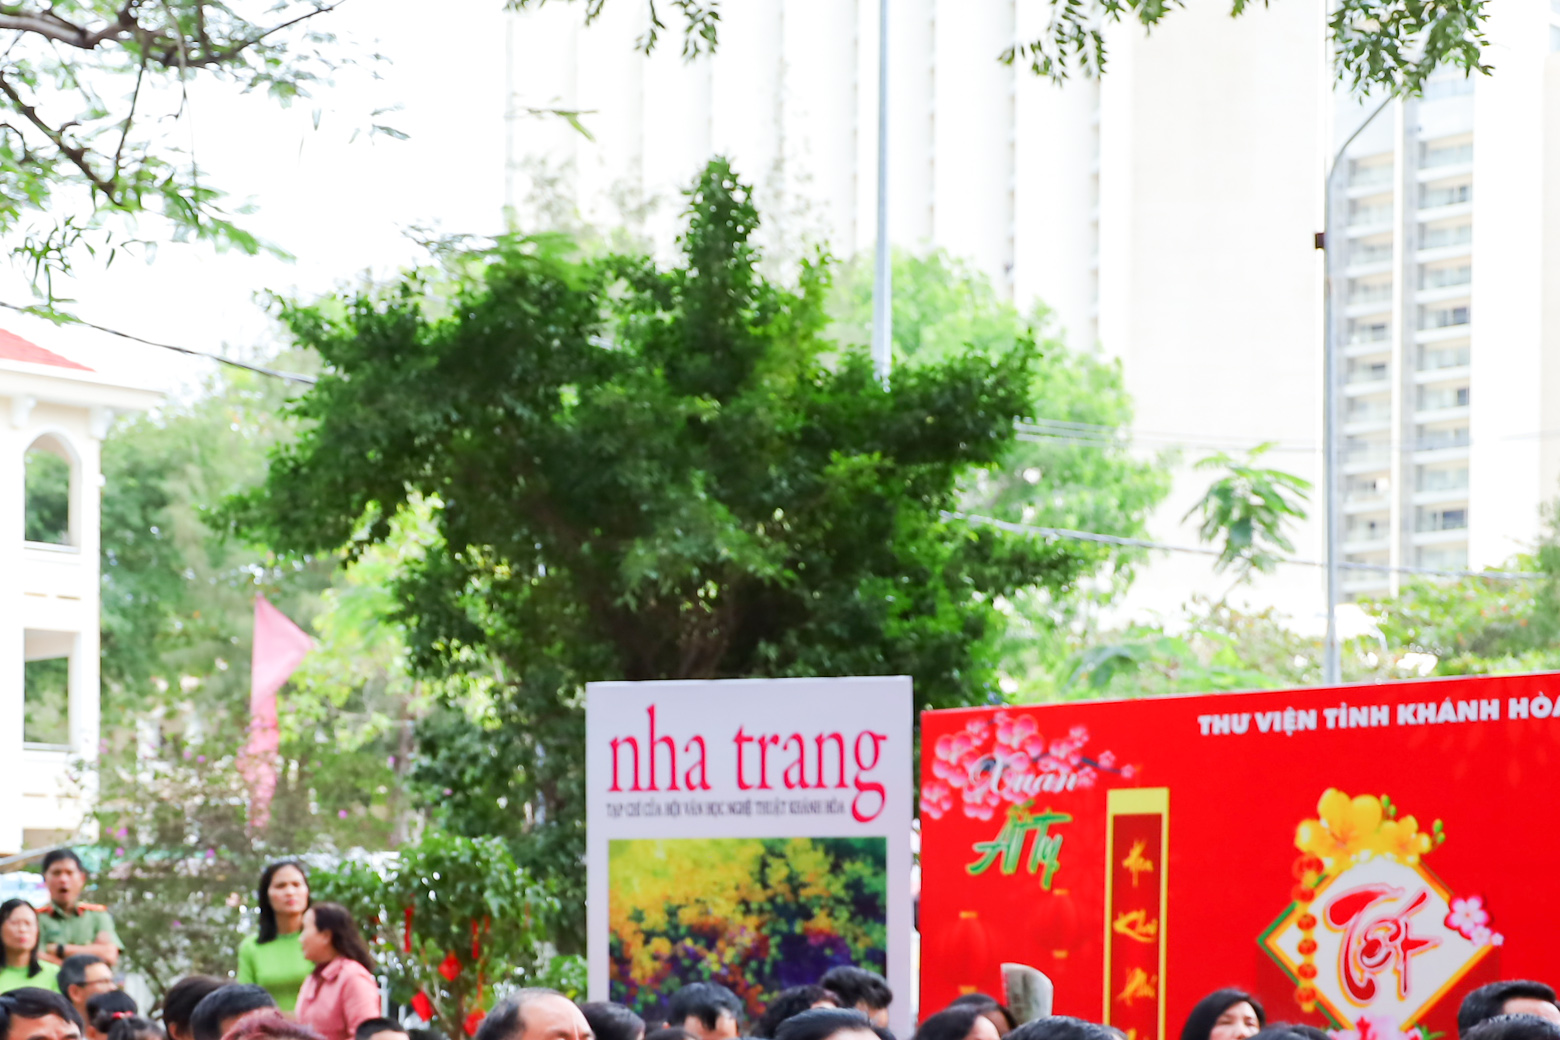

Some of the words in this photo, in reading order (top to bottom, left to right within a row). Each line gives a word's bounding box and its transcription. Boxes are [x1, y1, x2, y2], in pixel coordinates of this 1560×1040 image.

[608, 703, 712, 792] nha
[733, 725, 888, 823] trang
[1197, 713, 1251, 735] THƯ
[1254, 706, 1318, 736] VIỆN
[1323, 702, 1390, 729] TỈNH
[1396, 697, 1501, 726] KHÁNH
[1323, 882, 1444, 1008] Tết
